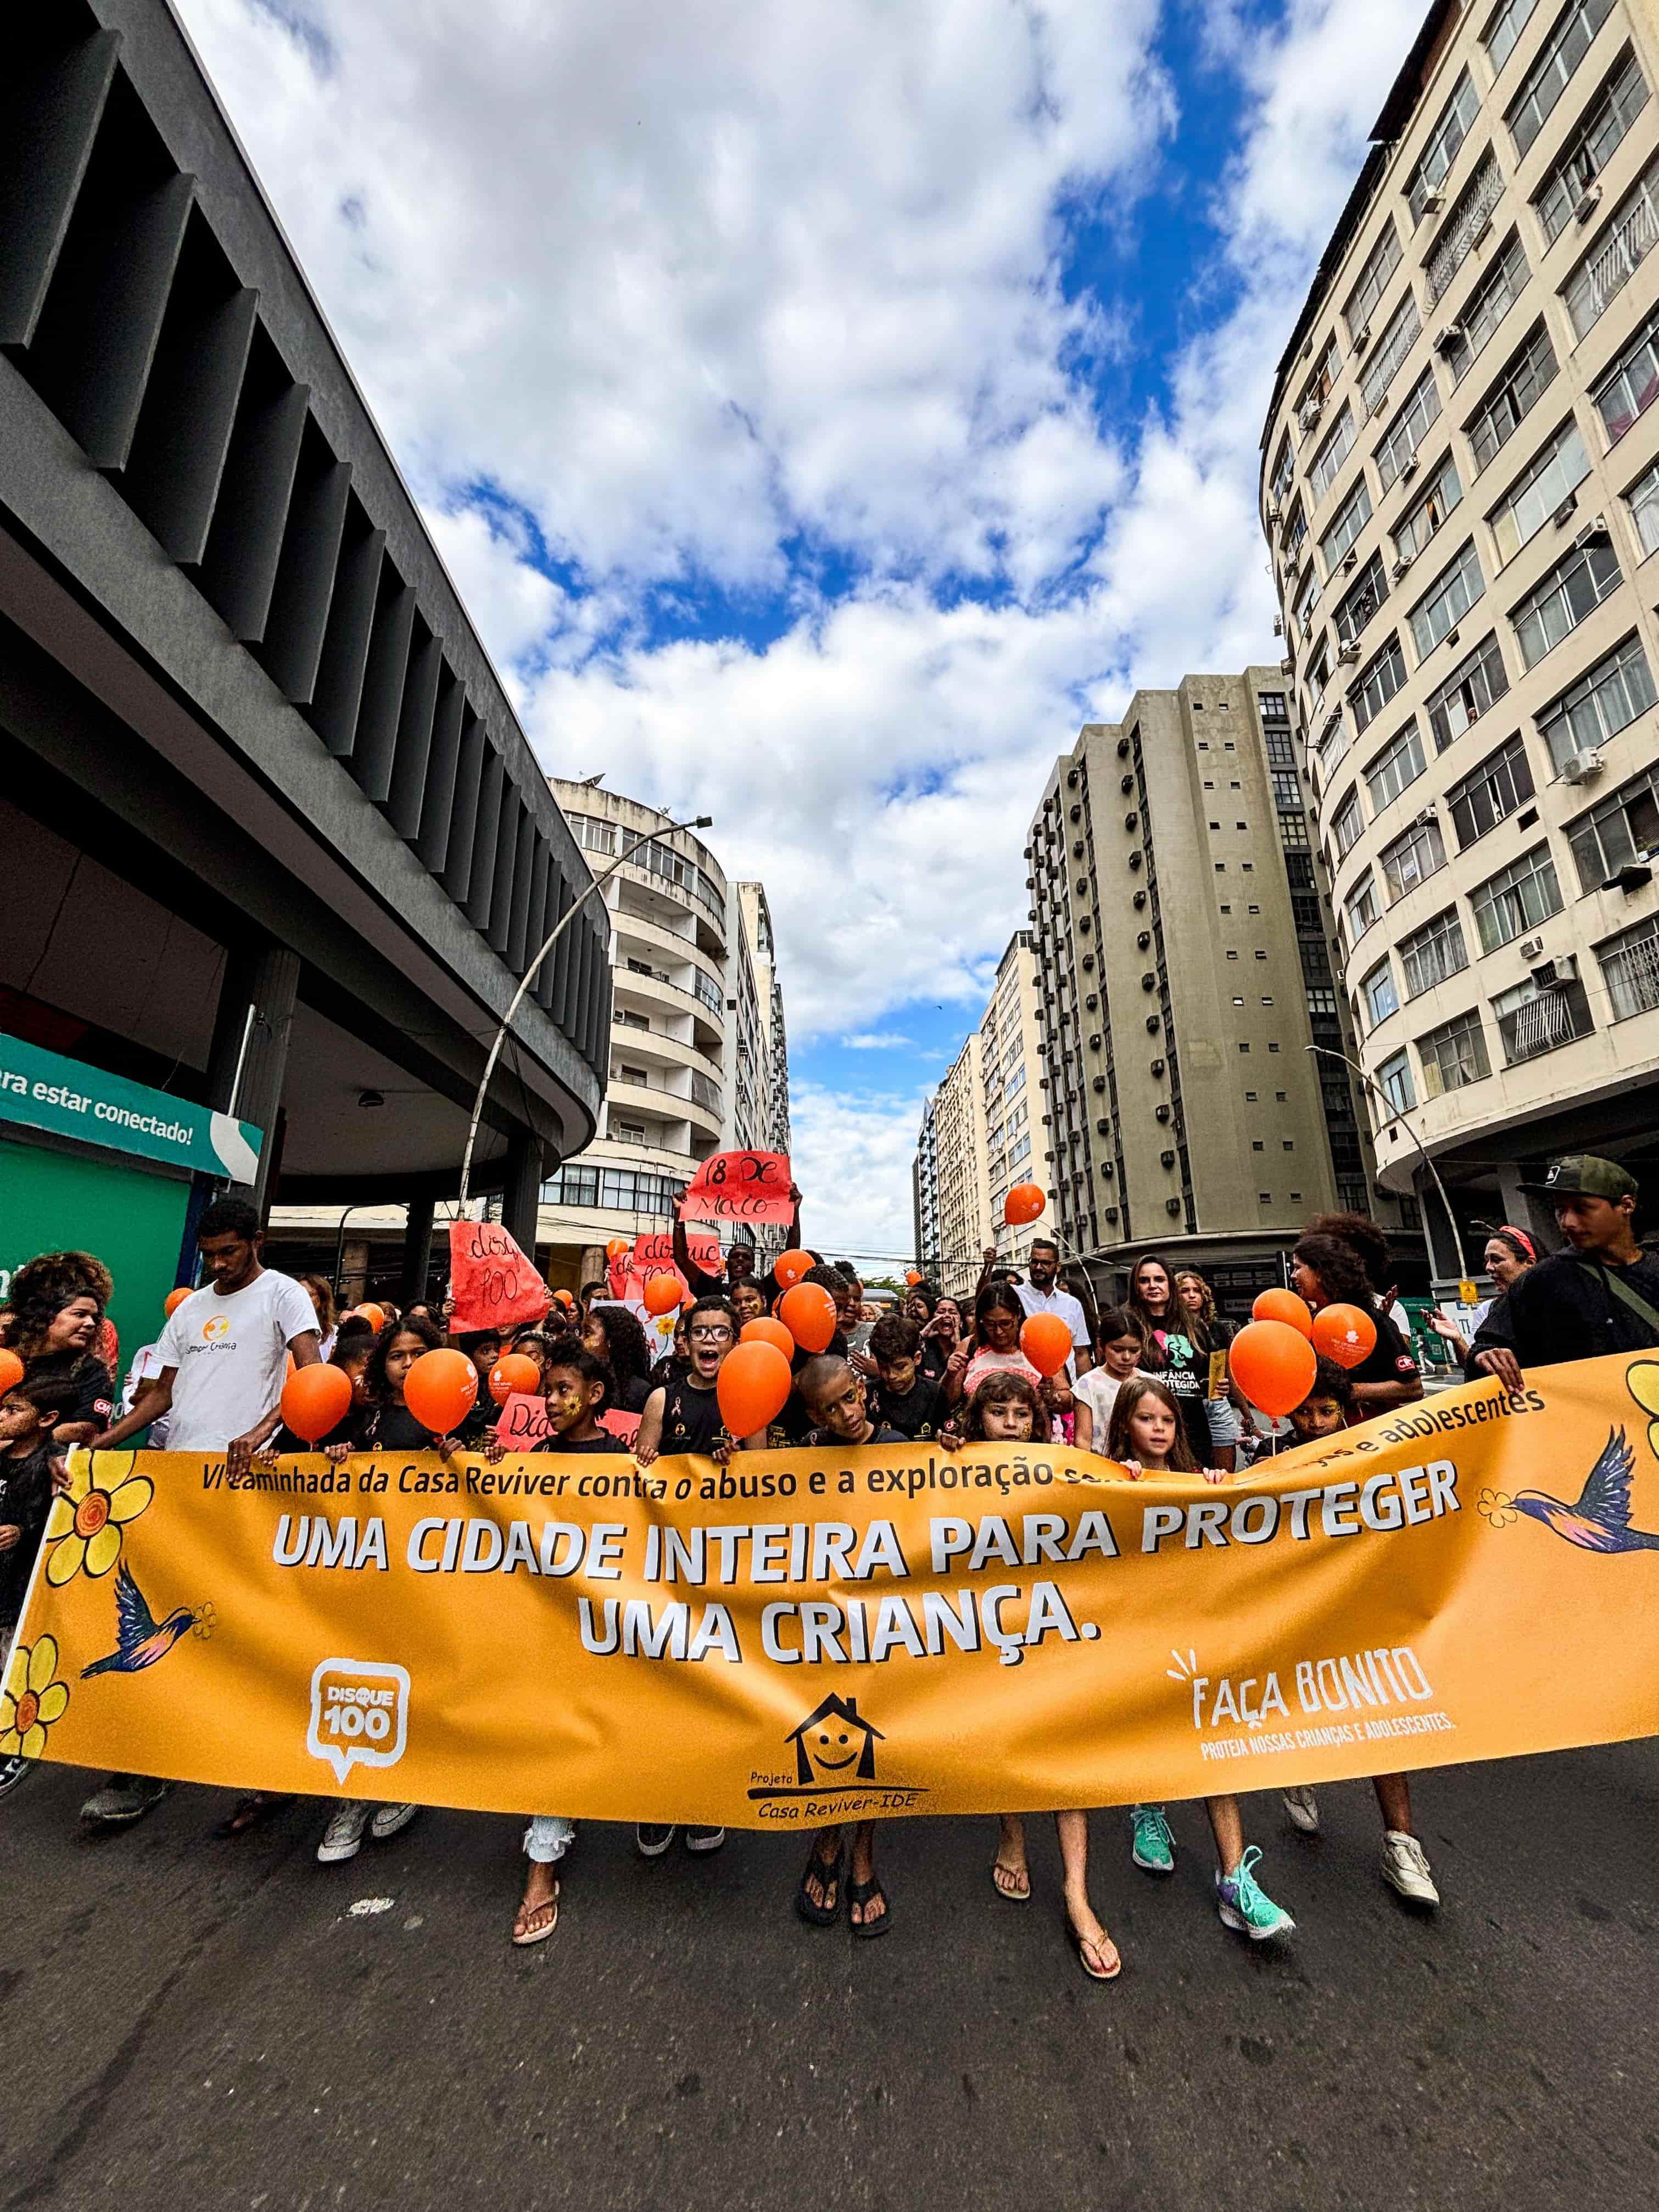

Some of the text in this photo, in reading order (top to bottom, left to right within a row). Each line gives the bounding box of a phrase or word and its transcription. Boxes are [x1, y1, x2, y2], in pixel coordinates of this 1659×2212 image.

[0, 1069, 193, 1146] ra estar conectado!
[706, 1158, 727, 1186] 18
[695, 1194, 779, 1215] Maio
[638, 1235, 719, 1261] disue
[510, 1404, 549, 1437] Dia
[203, 1464, 226, 1489] VI
[359, 1464, 389, 1493] da
[399, 1465, 459, 1493] Casa
[466, 1466, 571, 1495] Reviver
[578, 1470, 667, 1499] contra
[675, 1478, 691, 1500] o
[700, 1467, 797, 1500] abuso
[808, 1472, 825, 1494] e
[838, 1470, 854, 1494] a
[867, 1456, 1053, 1499] exploração
[1356, 1441, 1379, 1451] e
[1378, 1390, 1545, 1443] adolescentes
[273, 1459, 1462, 1585] UMA CIDADE INTEIRA PARA PROTEGER
[578, 1581, 1102, 1666] UMA CRIANÇA.
[327, 1686, 394, 1707] DISQUE
[1192, 1647, 1432, 1730] FAÇA BONITO
[324, 1705, 390, 1741] 100
[1200, 1712, 1456, 1761] PROTEJA NOSSAS CRIANÇAS E ADOLESCENTES.
[751, 1772, 793, 1786] Projeto
[758, 1792, 920, 1819] Casa Reviver-IDE
